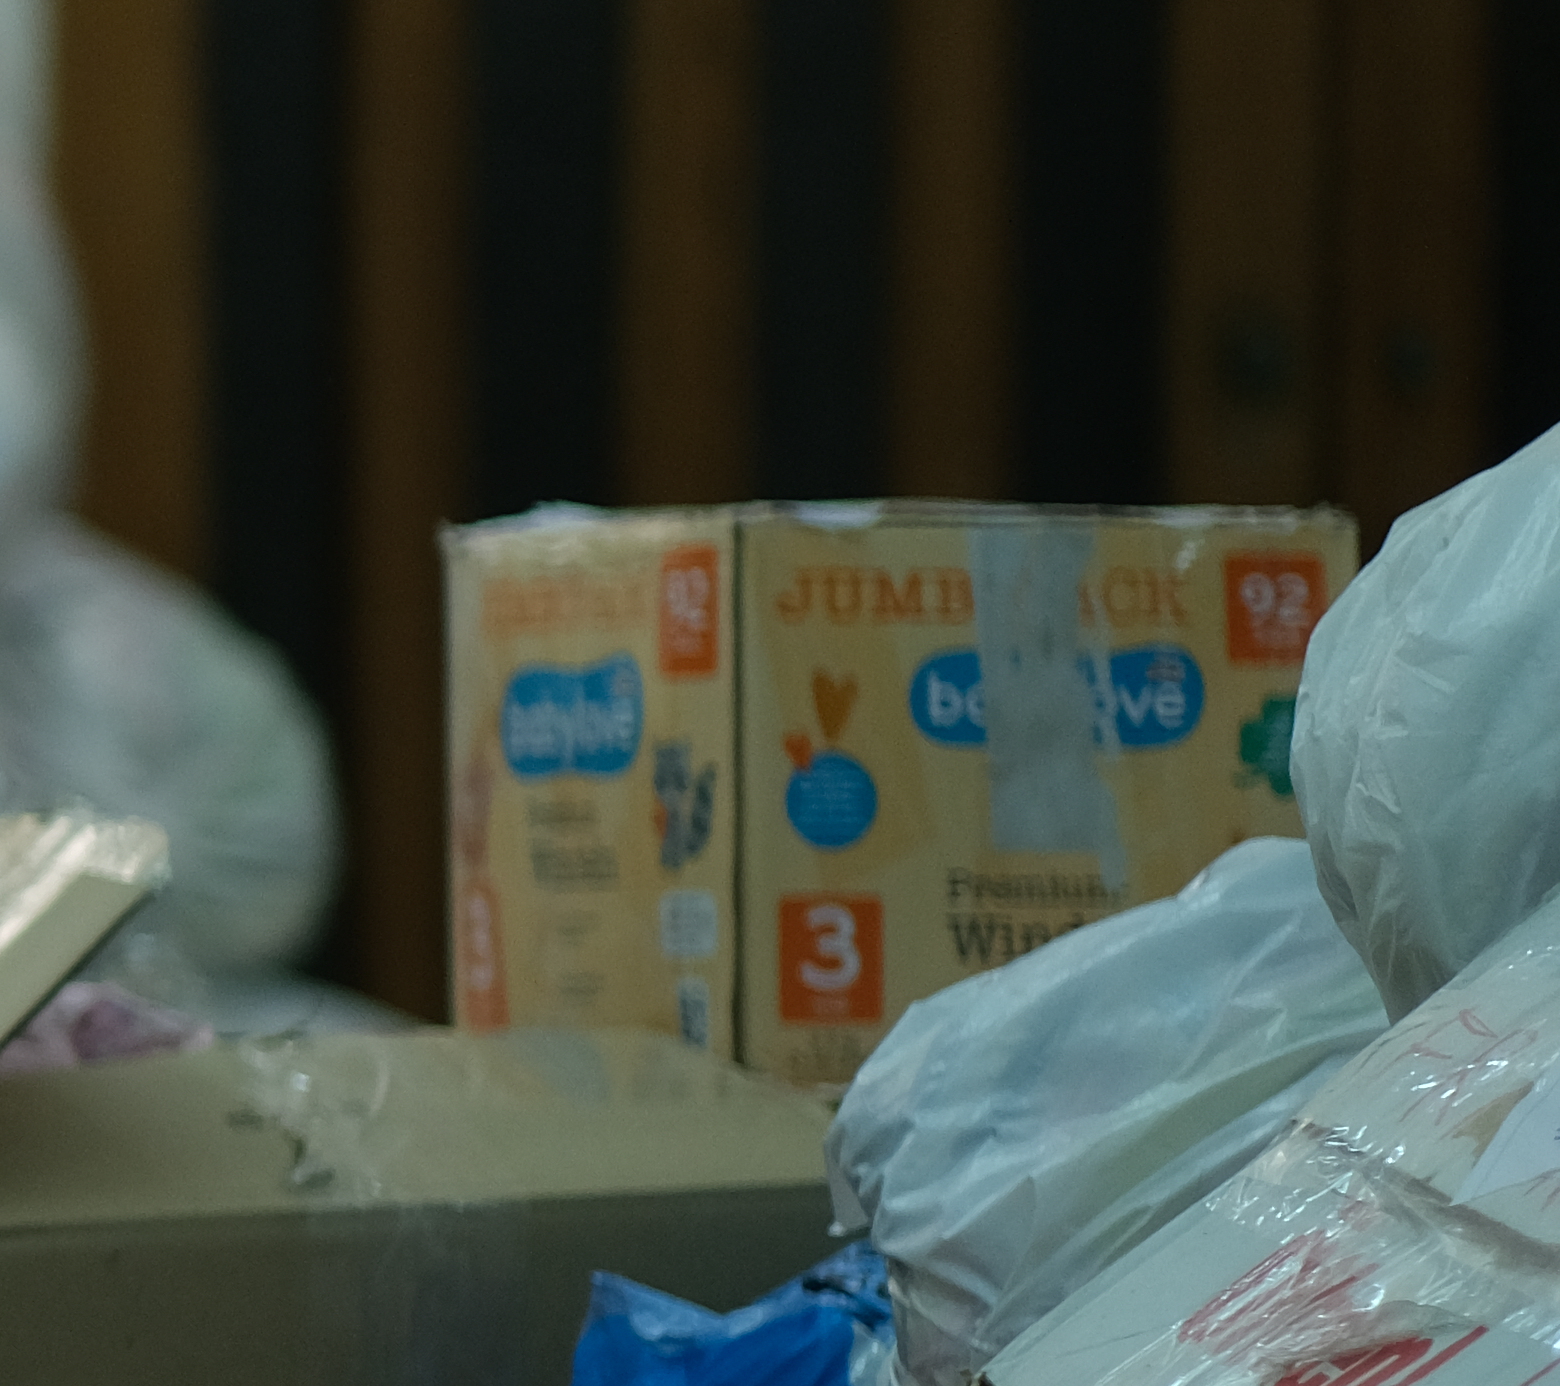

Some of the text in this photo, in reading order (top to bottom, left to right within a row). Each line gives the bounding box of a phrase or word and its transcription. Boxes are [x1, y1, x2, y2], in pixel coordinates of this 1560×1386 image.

[777, 566, 976, 628] JUMB
[1240, 571, 1311, 623] 92
[800, 904, 863, 991] 3
